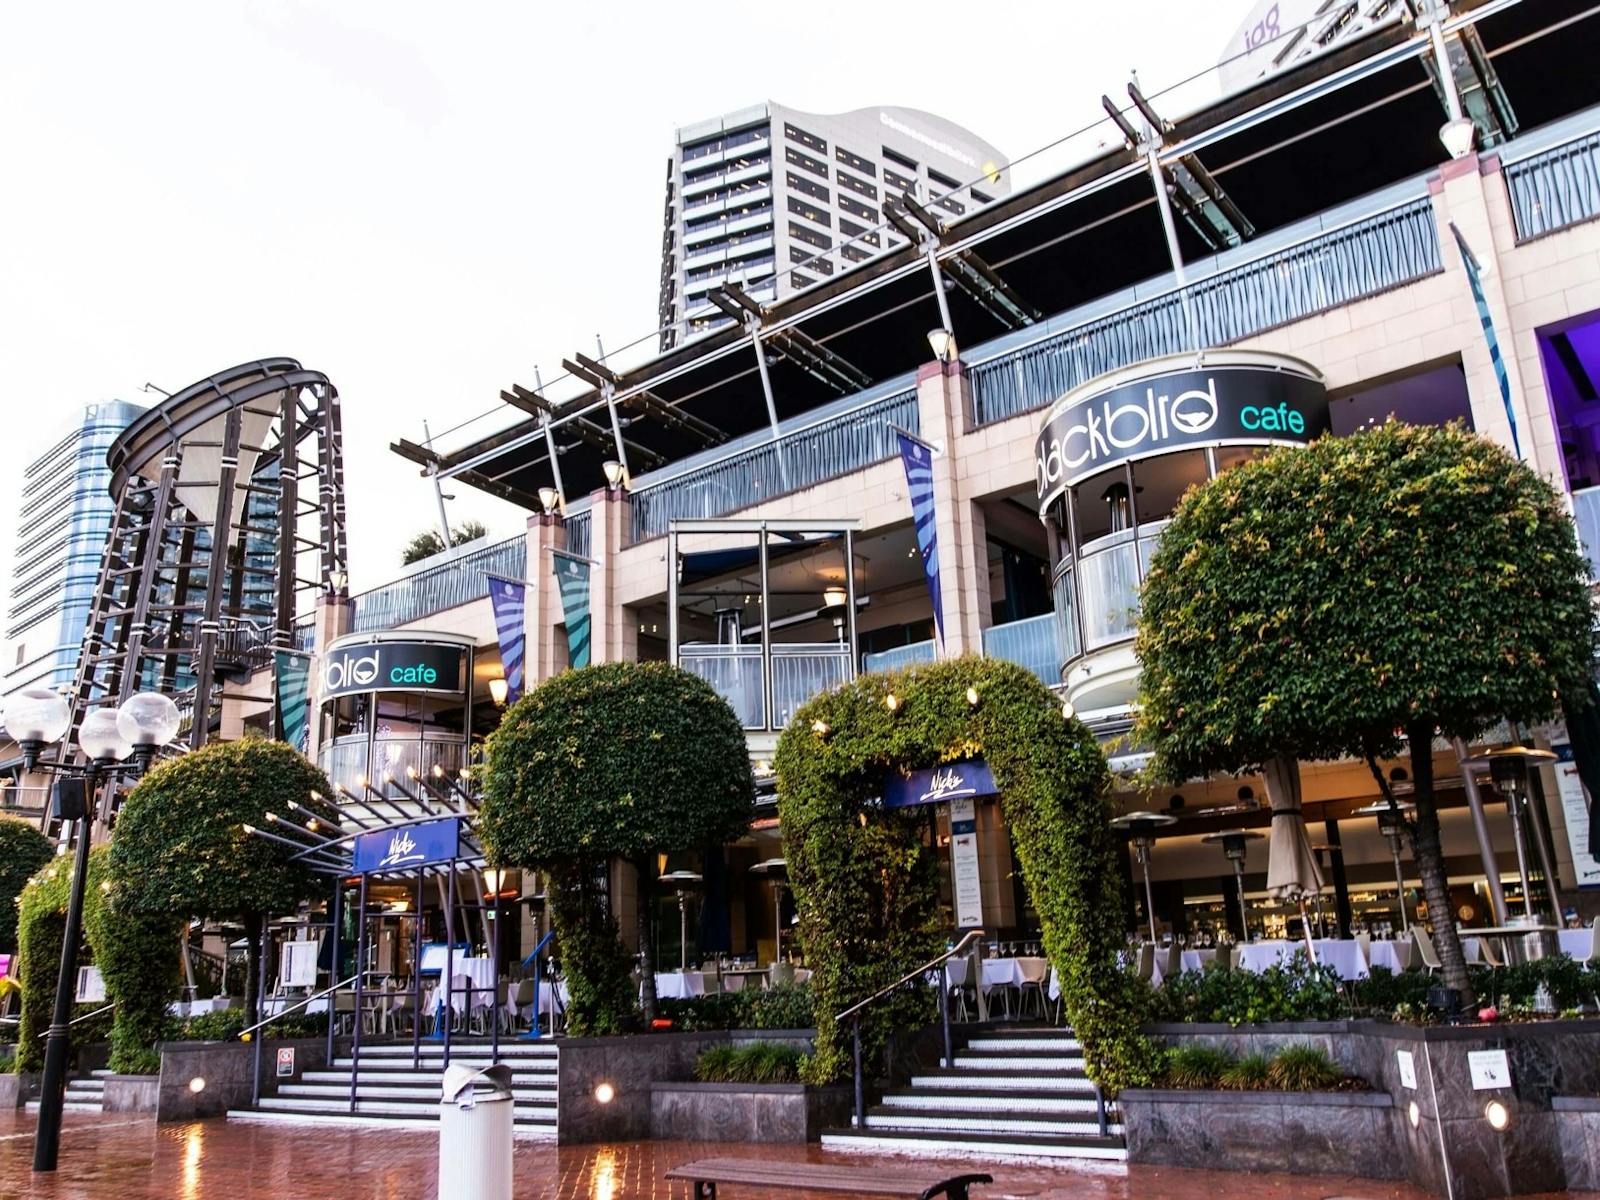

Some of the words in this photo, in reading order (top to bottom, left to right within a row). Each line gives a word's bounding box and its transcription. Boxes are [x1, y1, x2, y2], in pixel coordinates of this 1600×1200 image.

[1245, 2, 1280, 50] iag
[1240, 402, 1305, 434] cafe
[322, 650, 380, 692] bird
[390, 663, 437, 684] cafe
